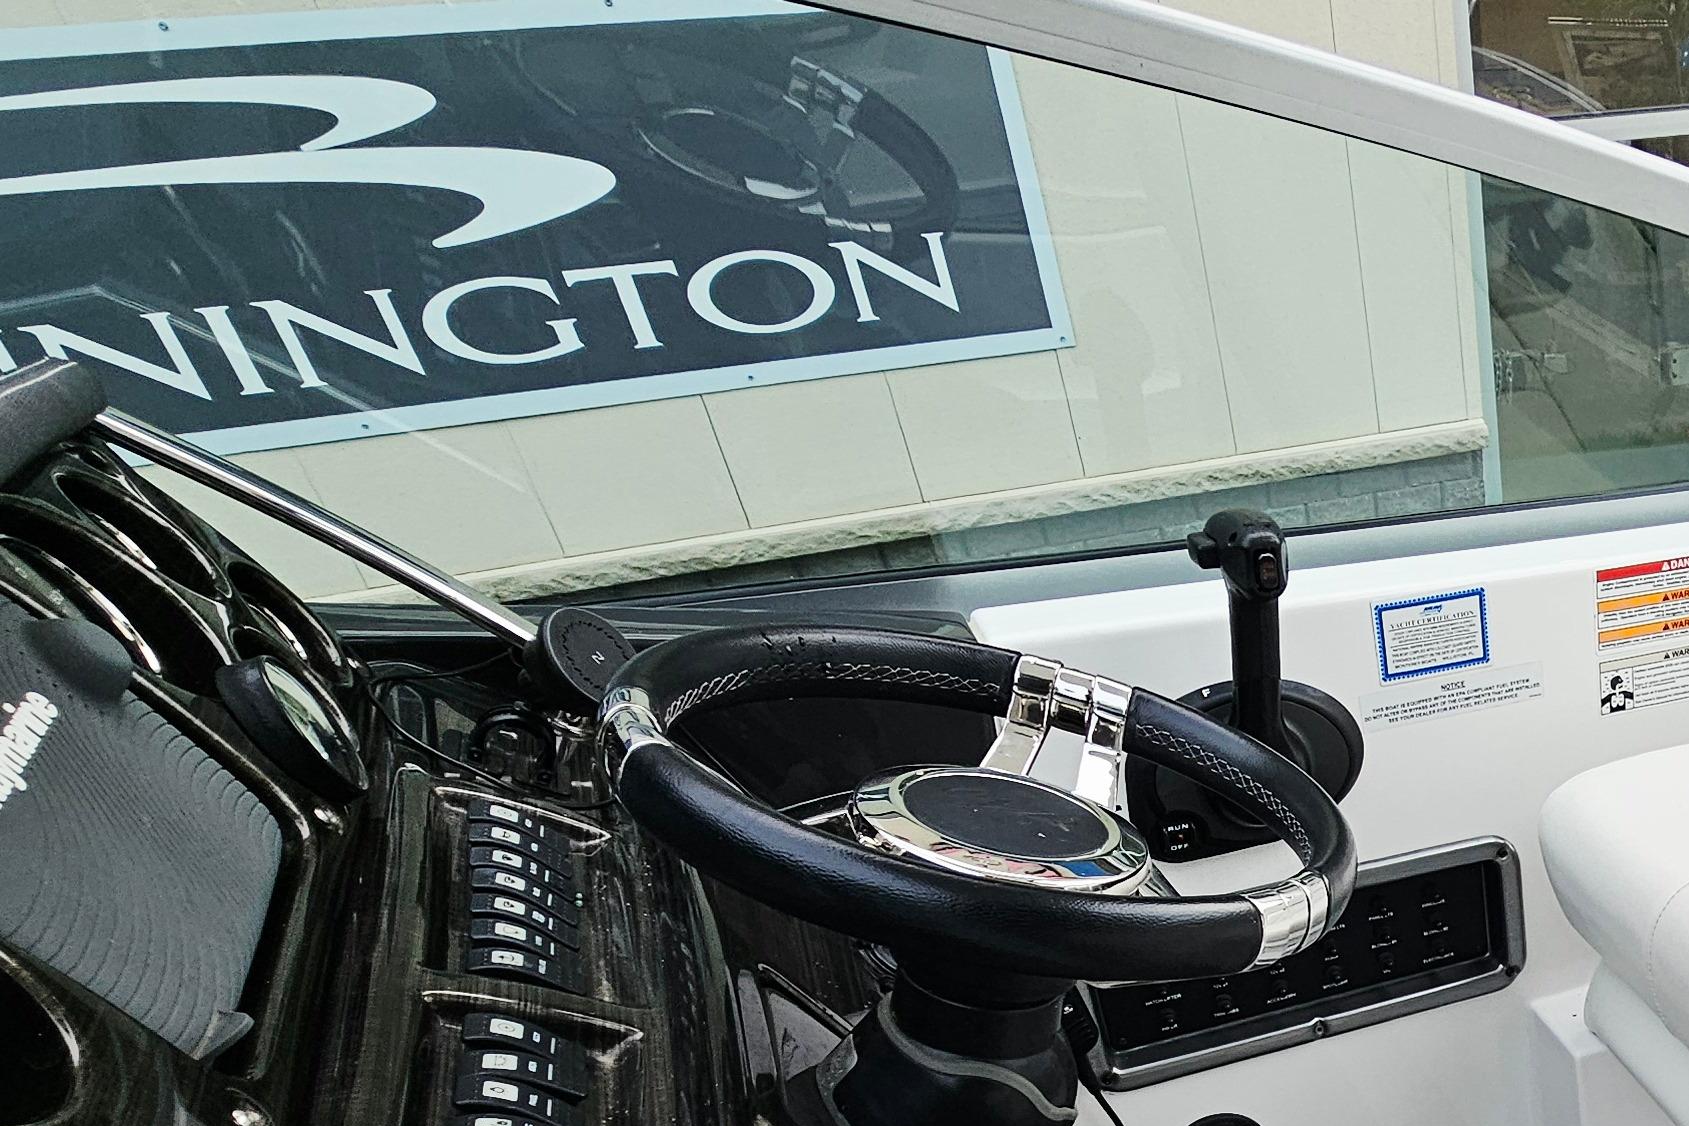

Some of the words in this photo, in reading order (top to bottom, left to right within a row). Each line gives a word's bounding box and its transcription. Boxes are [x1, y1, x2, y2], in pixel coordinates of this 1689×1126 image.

[0, 231, 960, 401] NINGTON
[1440, 680, 1466, 690] NOTICE
[1167, 823, 1189, 832] RUN
[1170, 843, 1189, 851] OFF
